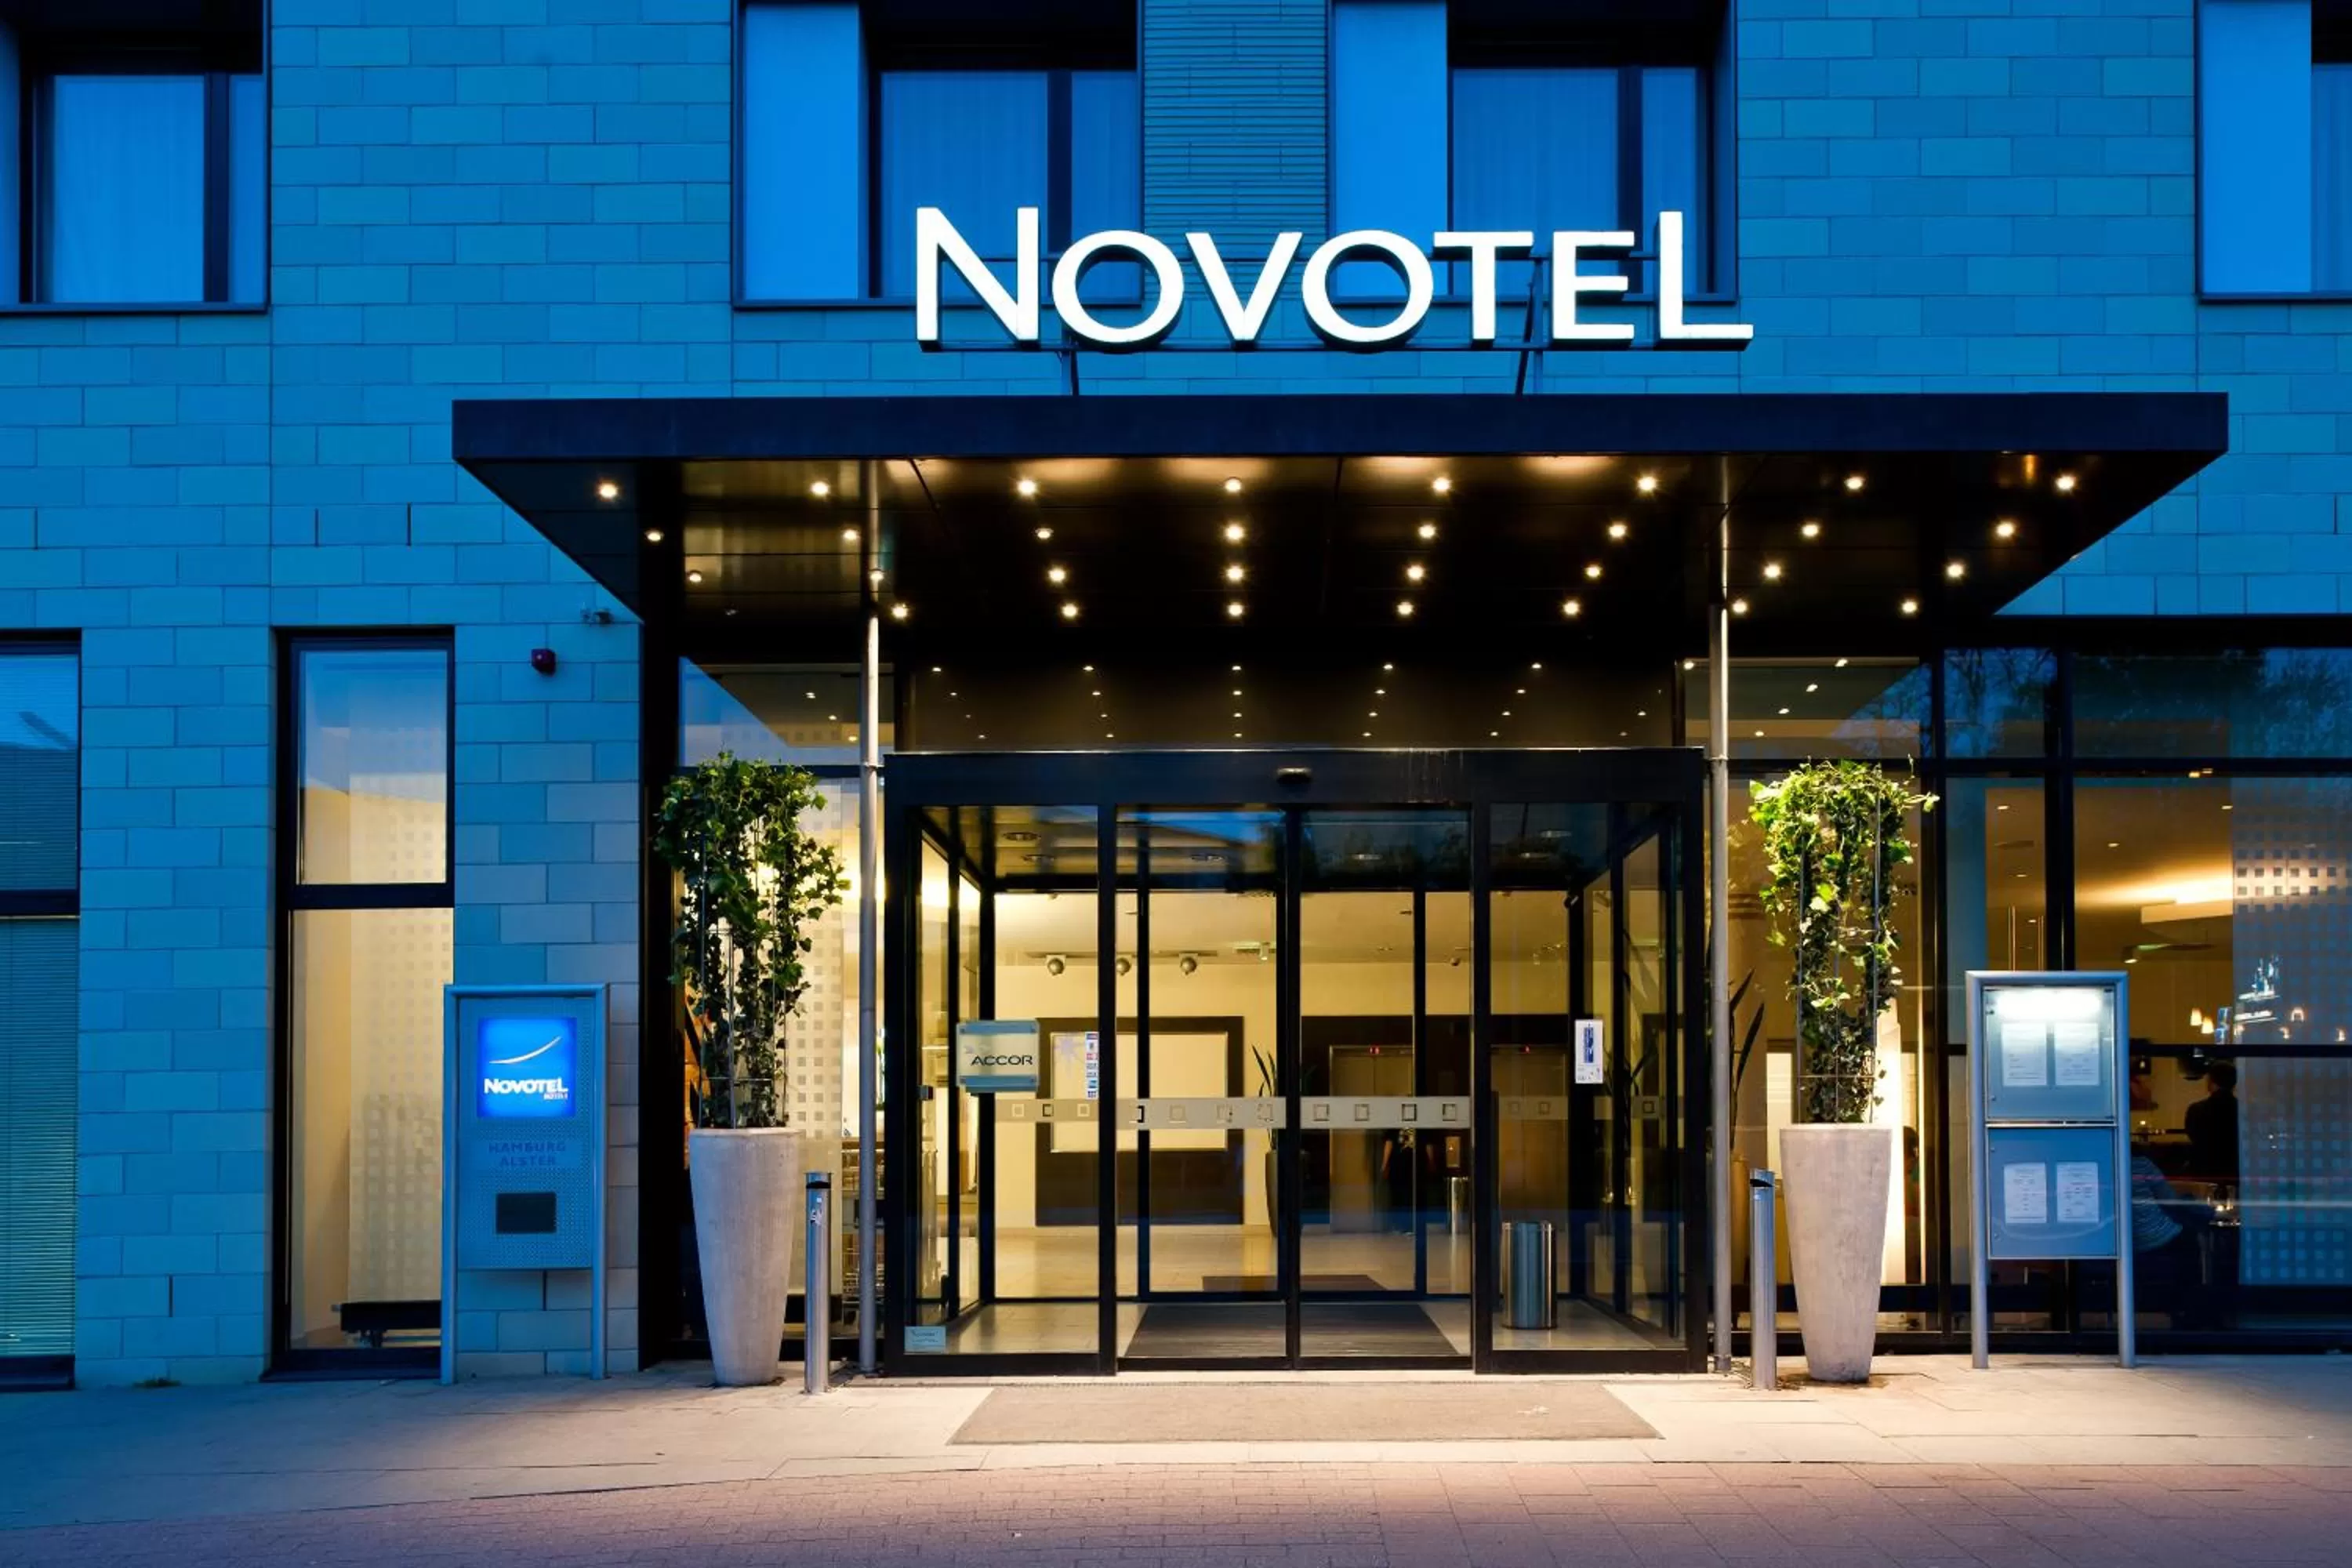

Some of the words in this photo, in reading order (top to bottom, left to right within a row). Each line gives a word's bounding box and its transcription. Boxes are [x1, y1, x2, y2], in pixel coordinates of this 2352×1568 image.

[916, 207, 1754, 345] NOVOTEL
[971, 1054, 1033, 1066] ACCOR
[484, 1077, 569, 1094] NOVOTEL
[488, 1142, 565, 1153] HAMBURG
[499, 1155, 556, 1166] ALSTER
